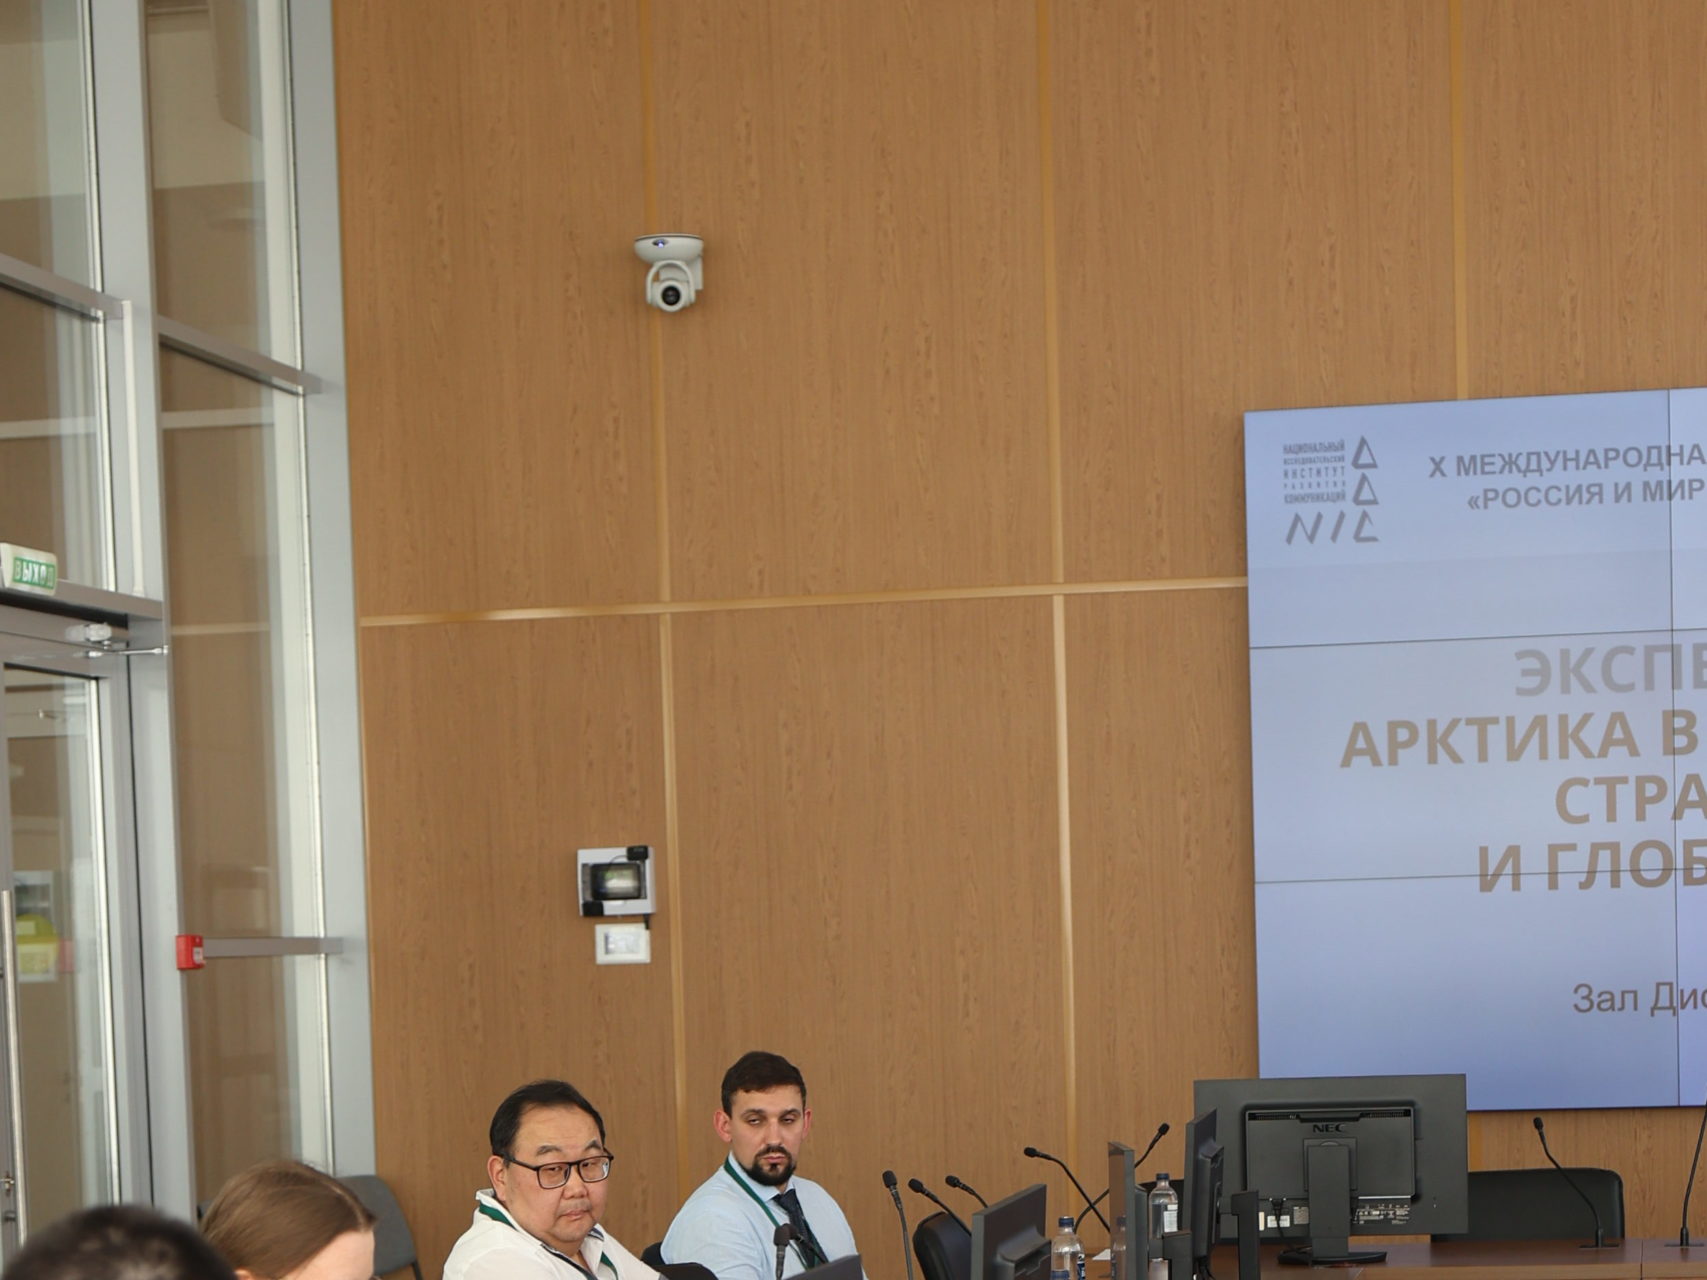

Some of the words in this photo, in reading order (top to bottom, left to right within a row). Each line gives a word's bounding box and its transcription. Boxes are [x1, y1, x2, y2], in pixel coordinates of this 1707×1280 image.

[1455, 443, 1707, 478] МЕЖДУНАРОДНА
[1467, 482, 1604, 510] «РОССИЯ
[1614, 482, 1633, 503] И
[1642, 478, 1705, 503] МИР
[15, 559, 54, 588] ВЫХОД
[1340, 711, 1641, 768] АРКТИКА
[1662, 709, 1698, 757] В
[1555, 773, 1707, 825] СТРА
[1478, 845, 1521, 892] И
[1547, 839, 1707, 891] ГЛОБ
[1573, 983, 1638, 1013] Зал
[1312, 1123, 1346, 1133] NEC
